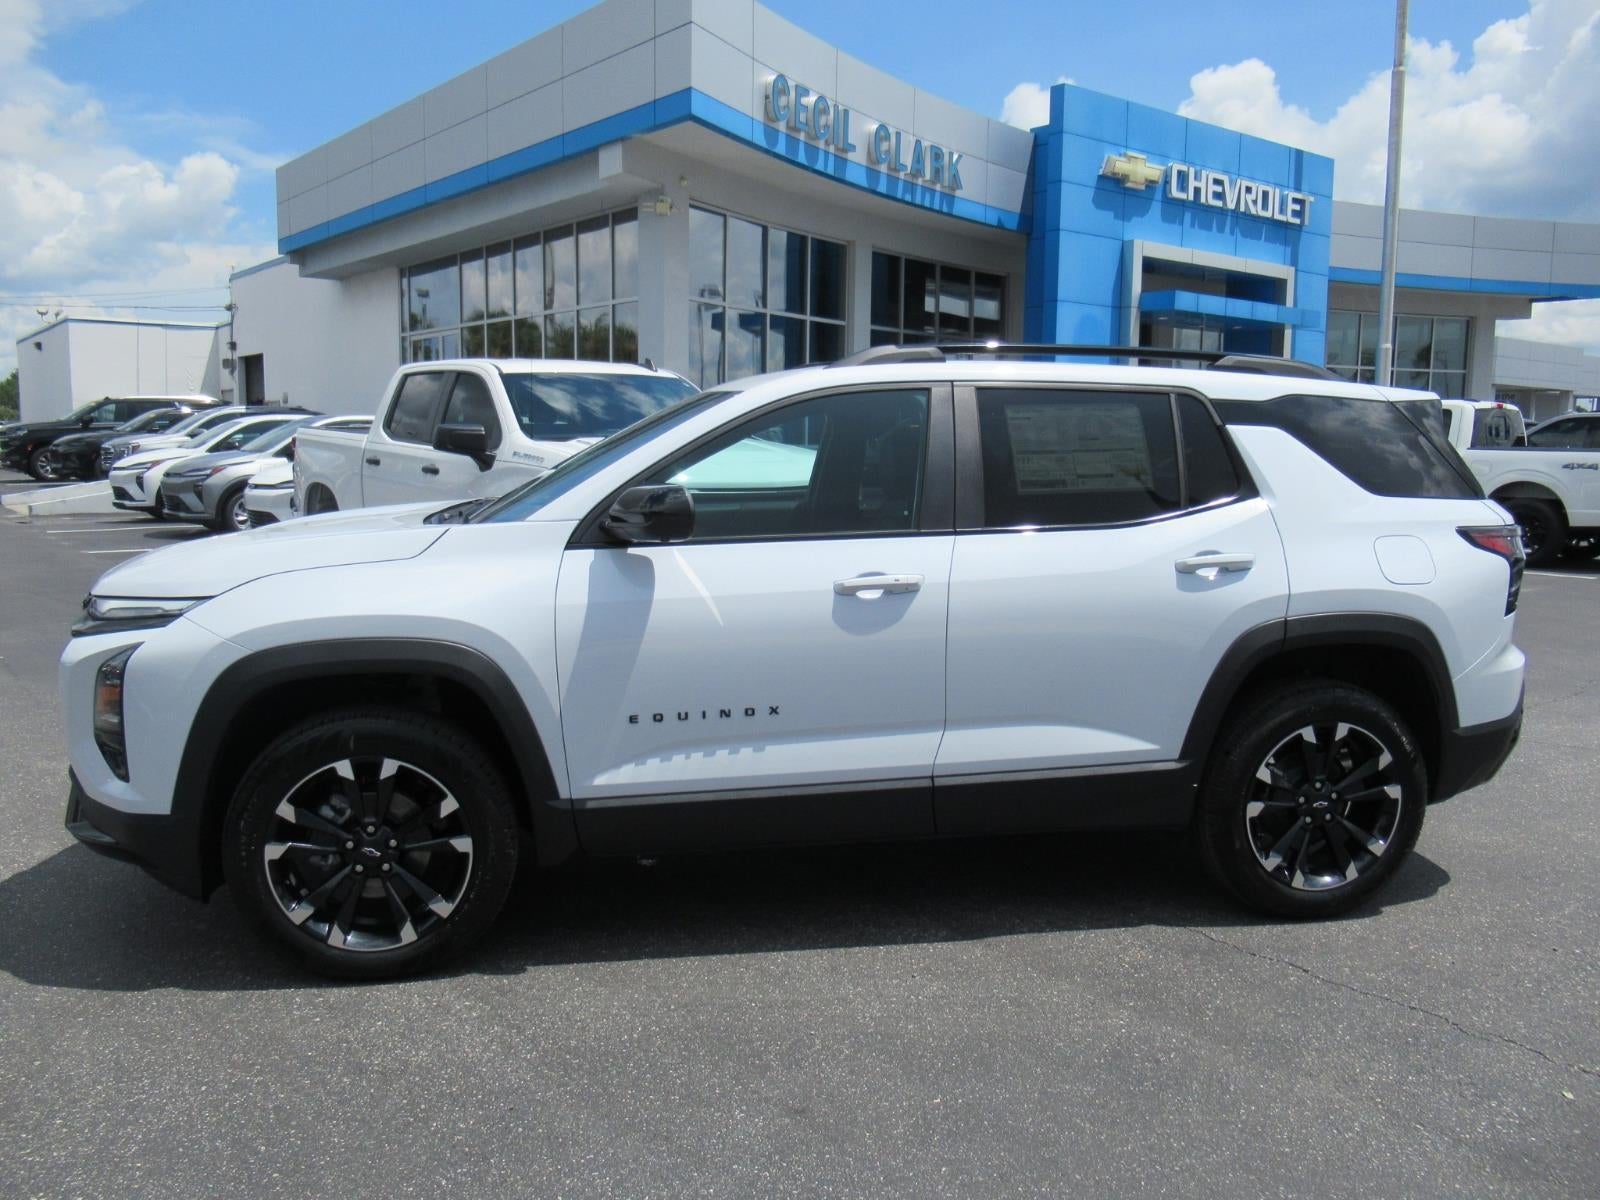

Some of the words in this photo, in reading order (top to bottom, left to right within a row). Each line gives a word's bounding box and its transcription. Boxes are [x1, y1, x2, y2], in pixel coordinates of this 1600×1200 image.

[765, 73, 857, 153] CECIL
[869, 123, 964, 191] CLARK
[1167, 161, 1315, 226] CHEVROLET
[628, 705, 780, 724] EQUINOX
